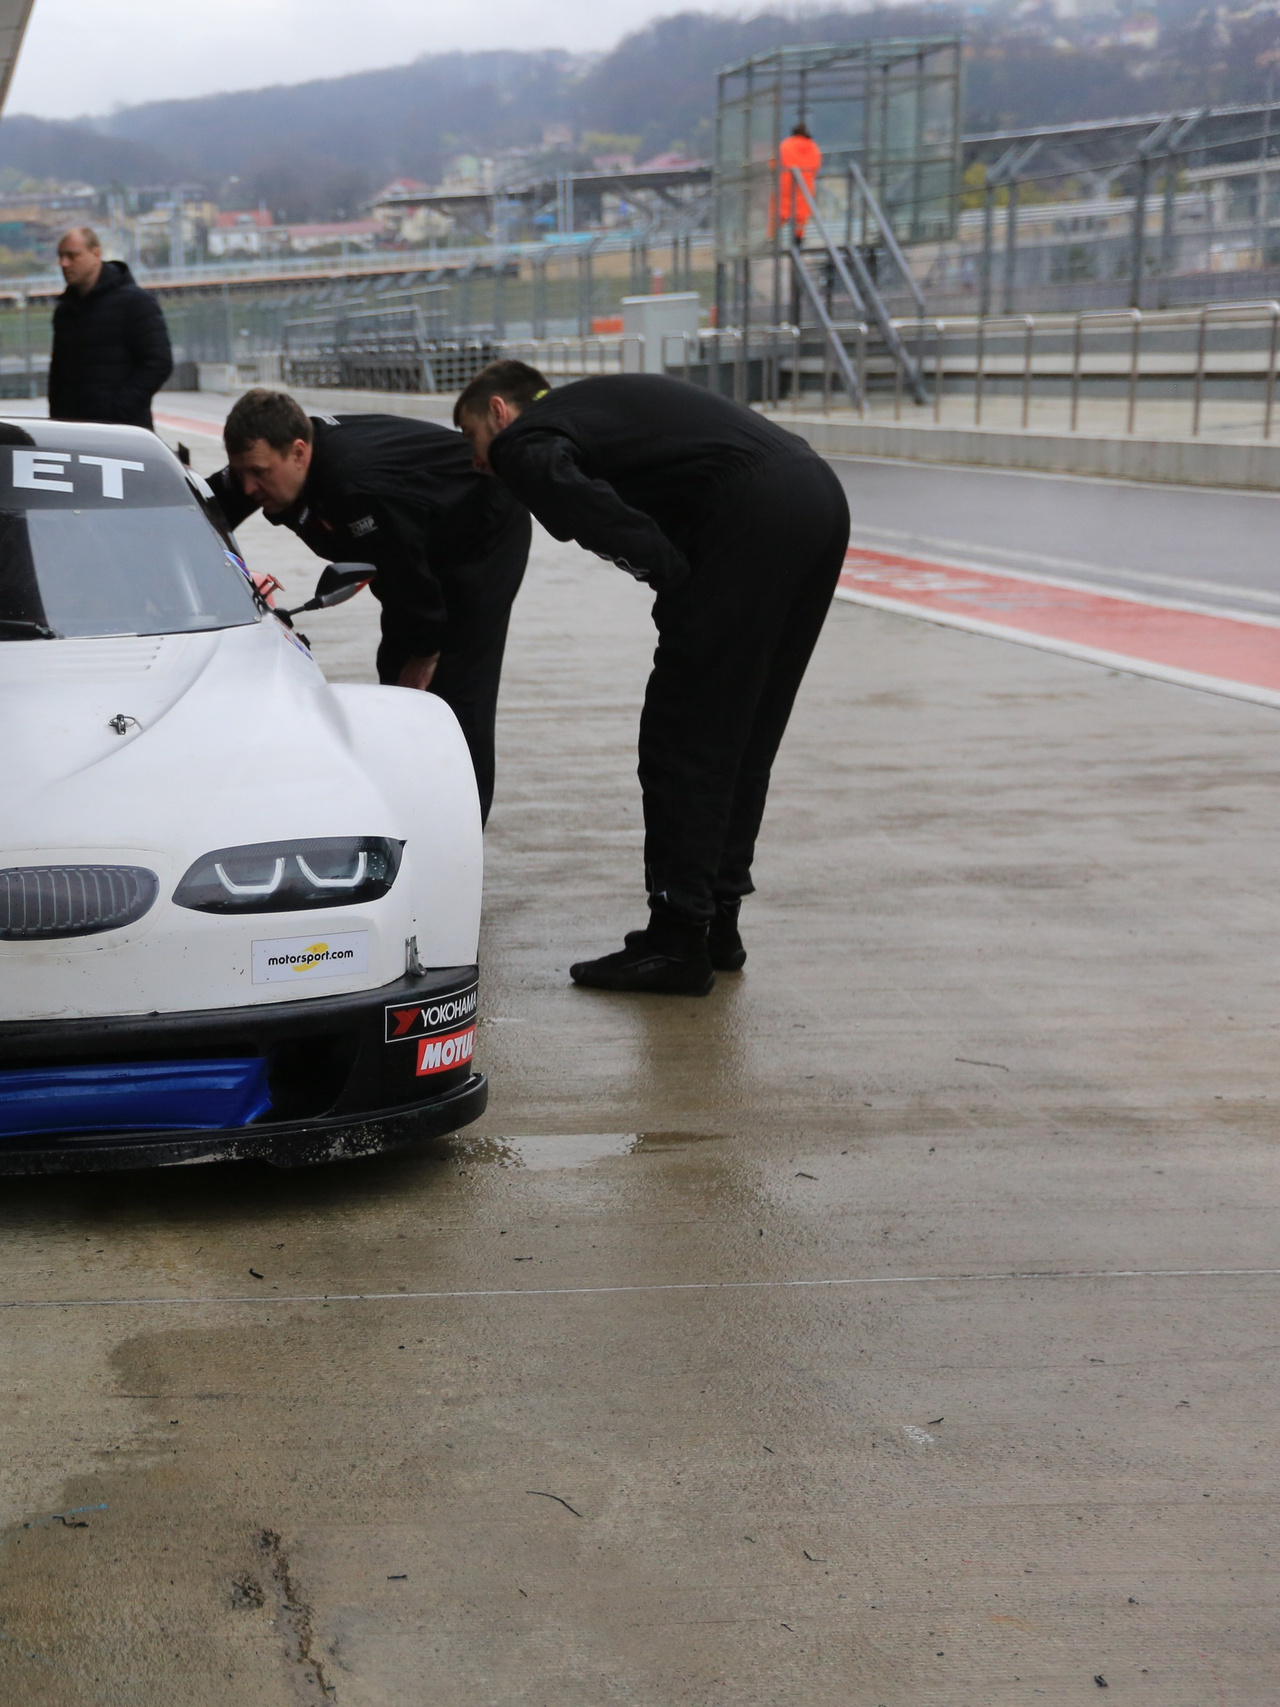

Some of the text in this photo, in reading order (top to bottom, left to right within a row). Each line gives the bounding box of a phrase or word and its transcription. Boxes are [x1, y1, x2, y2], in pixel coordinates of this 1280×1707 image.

[267, 949, 354, 966] motorsport.com
[420, 990, 477, 1028] YOKOHAMA
[420, 1030, 474, 1071] MOTUL
